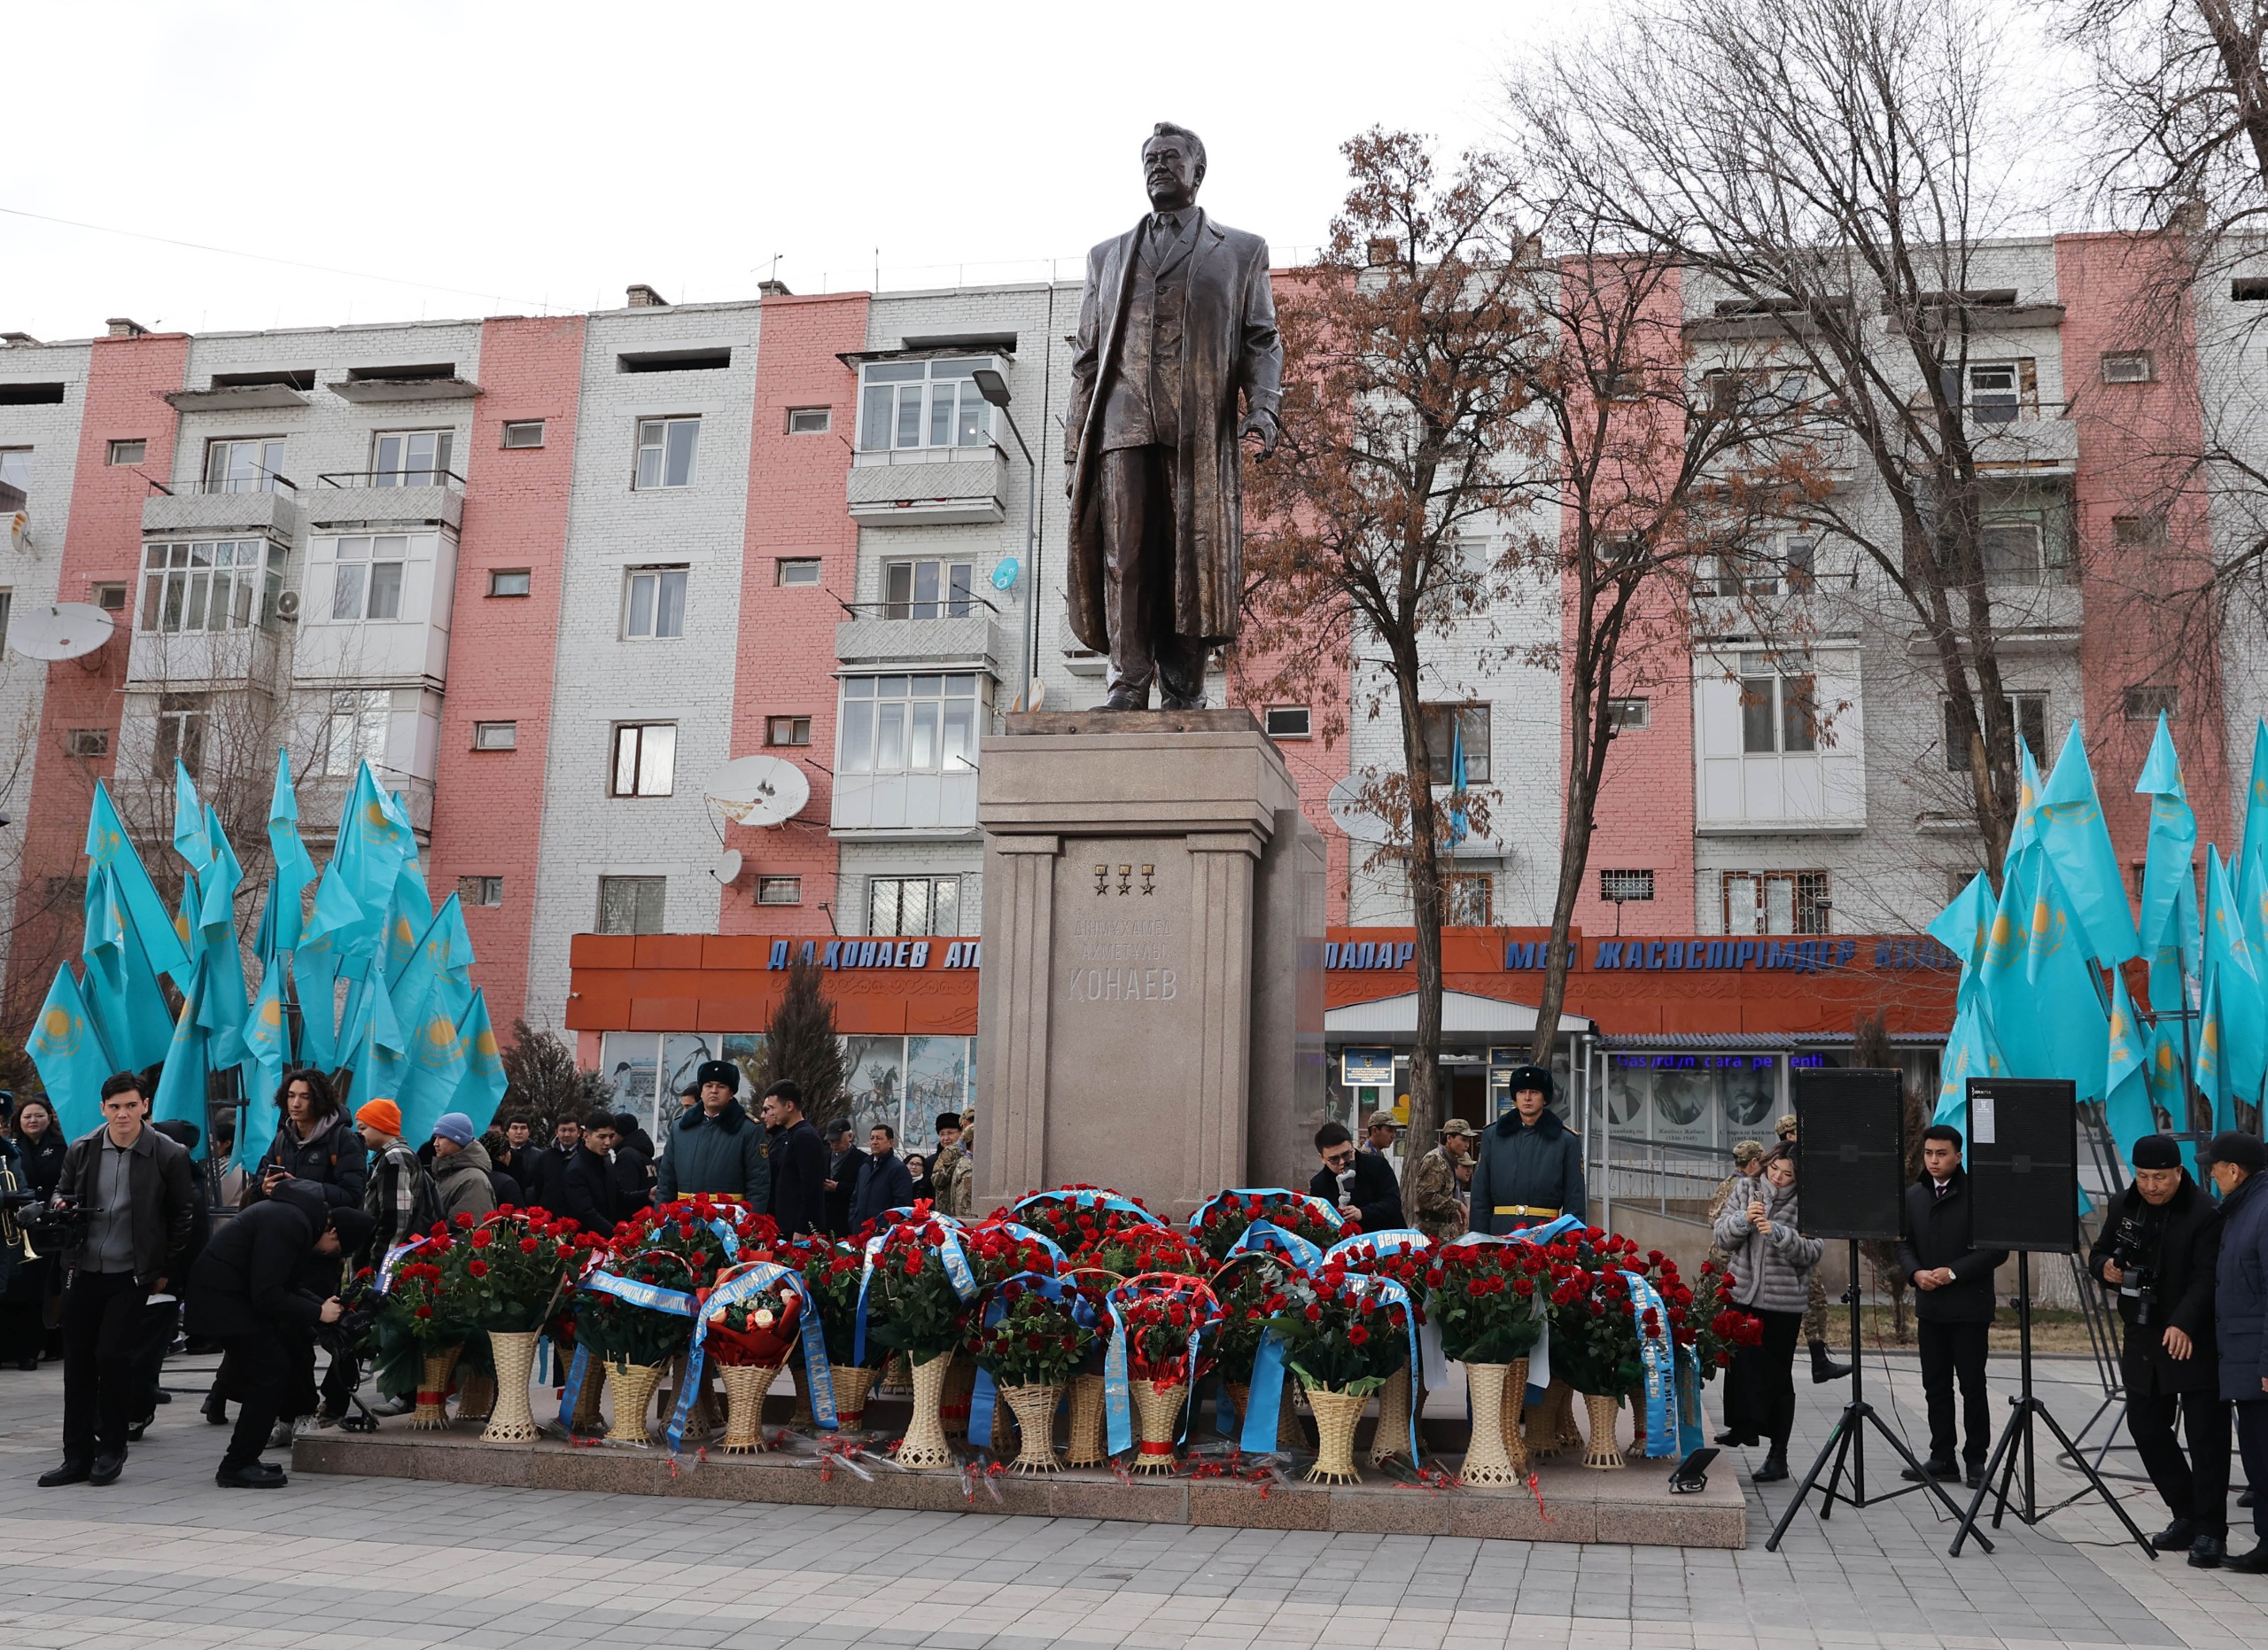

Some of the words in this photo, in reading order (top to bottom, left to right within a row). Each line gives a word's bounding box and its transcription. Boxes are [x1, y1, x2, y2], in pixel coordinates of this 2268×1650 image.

[1074, 919, 1173, 937] ДІНМҰХАМЕД
[1082, 943, 1167, 961] АХМЕТҰЛЫ
[1068, 967, 1177, 1003] ҚОНАЕВ
